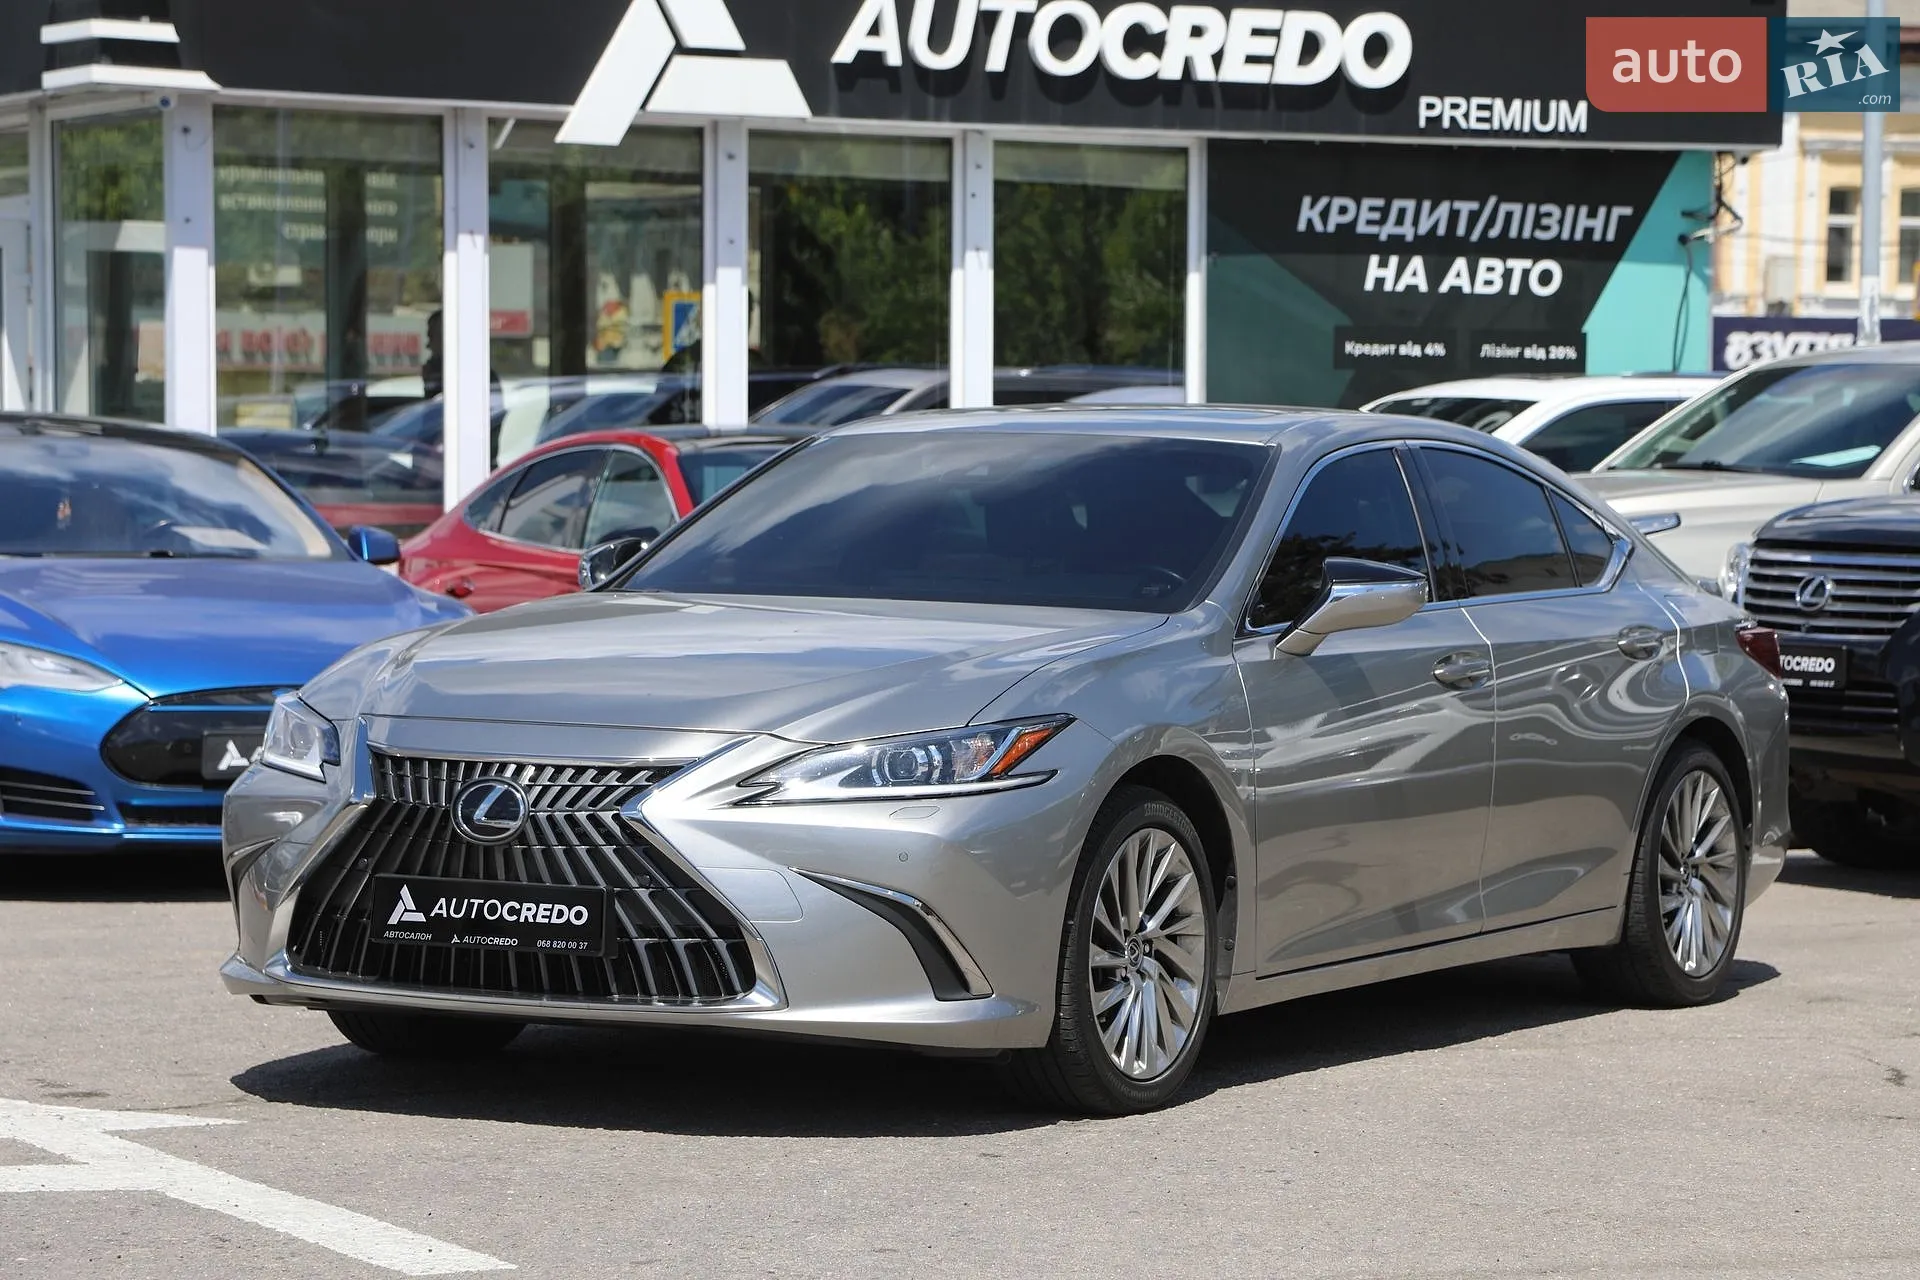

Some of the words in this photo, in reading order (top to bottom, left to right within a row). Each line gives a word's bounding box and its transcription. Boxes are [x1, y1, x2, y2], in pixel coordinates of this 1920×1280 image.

[831, 0, 1413, 89] AUTOCREDO
[1418, 95, 1588, 133] PREMIUM
[1297, 195, 1634, 243] КРЕДИТ/ЛІЗІНГ
[1364, 255, 1429, 293] НА
[1438, 256, 1563, 297] АВТО
[1344, 340, 1397, 358] Кредит
[1398, 340, 1423, 359] від
[1424, 342, 1447, 357] 4%
[1479, 343, 1523, 359] Лізінг
[1523, 343, 1547, 361] від
[1548, 345, 1578, 360] 20%
[1780, 654, 1836, 674] TOCREDO
[429, 897, 589, 926] AUTOCREDO
[383, 930, 433, 941] АВТОСАЛОН
[462, 935, 519, 946] AUTOCREDO
[536, 939, 551, 948] 068
[552, 940, 566, 949] 820
[567, 941, 577, 949] 00
[578, 941, 588, 950] 37
